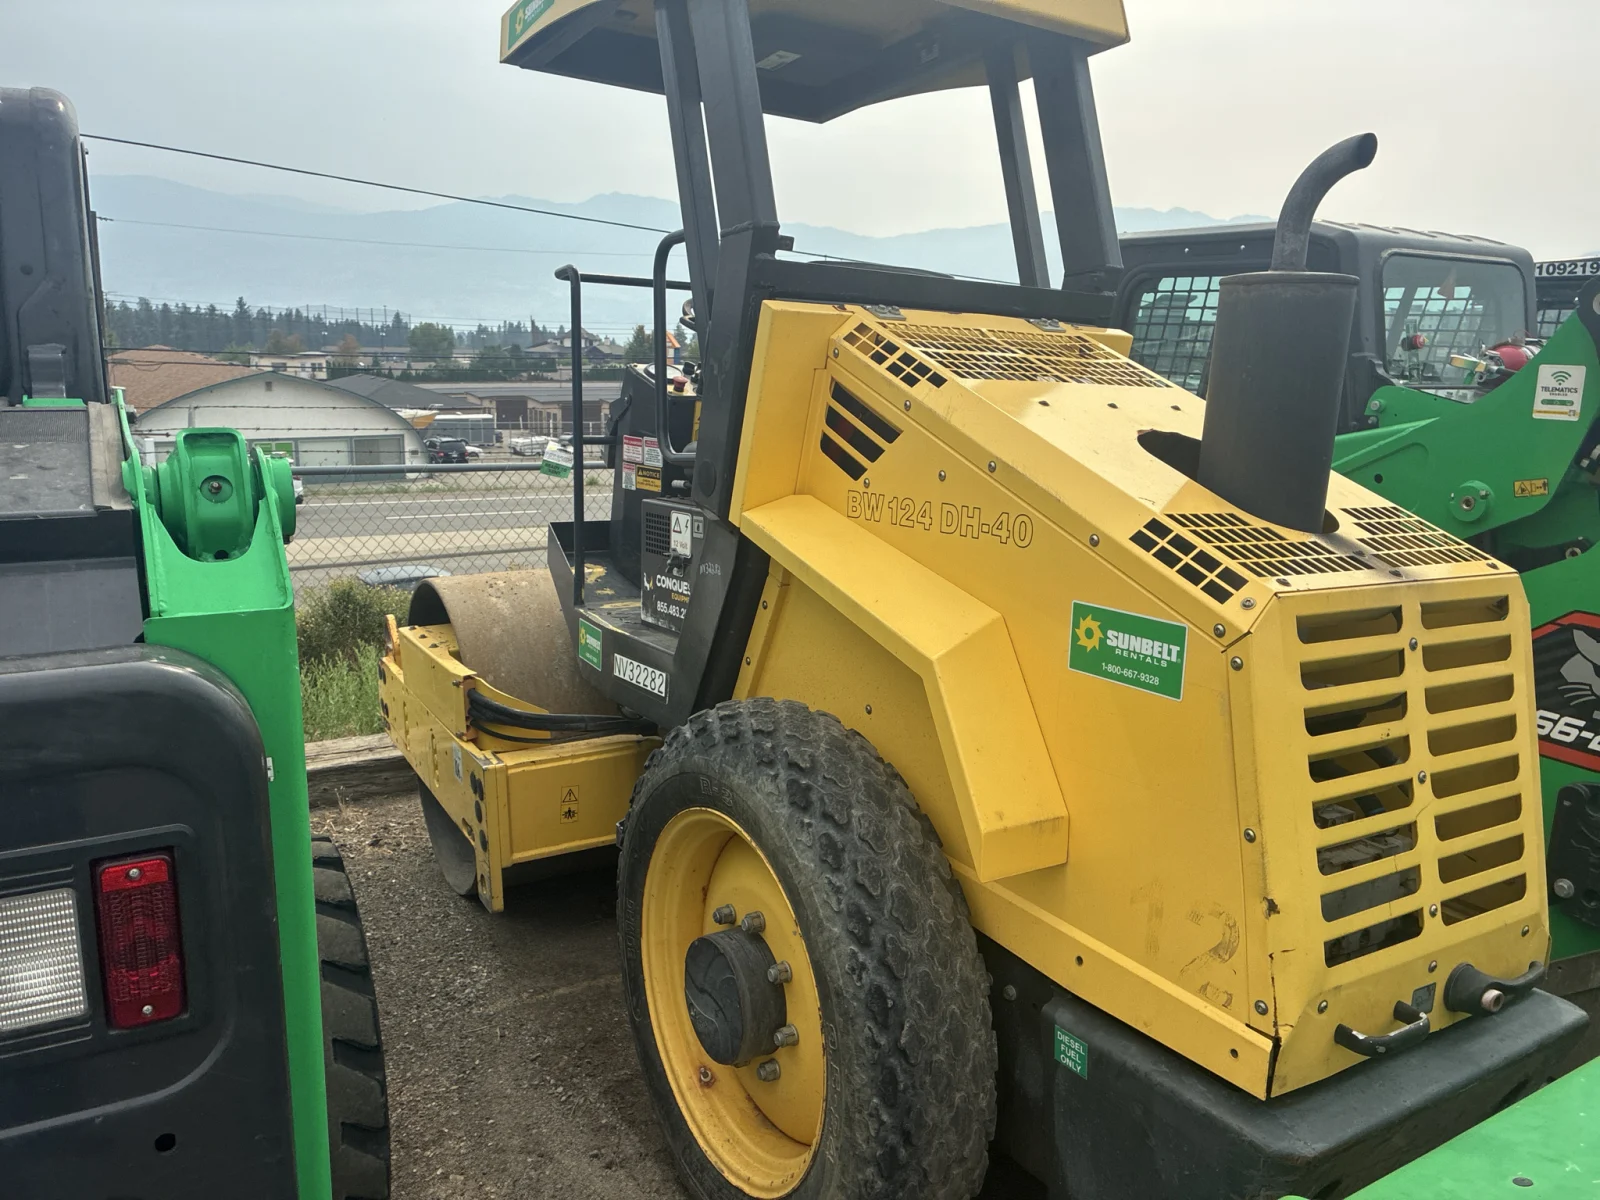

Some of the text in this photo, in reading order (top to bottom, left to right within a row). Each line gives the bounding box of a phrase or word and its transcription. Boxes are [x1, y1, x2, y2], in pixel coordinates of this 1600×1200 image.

[1537, 261, 1600, 276] 109219
[1541, 386, 1578, 394] TELEMATICS
[642, 469, 660, 479] NOTICE
[846, 489, 1034, 549] BW 124 DH-40
[673, 539, 679, 548] 12
[1106, 629, 1180, 663] SUNBELT
[1115, 649, 1168, 668] RENTALS
[614, 655, 665, 695] NV32282
[1101, 662, 1160, 686] 1-800-667-9328
[1057, 1031, 1086, 1056] DIESEL
[1060, 1043, 1082, 1064] FUEL
[1060, 1054, 1082, 1073] ONLY
